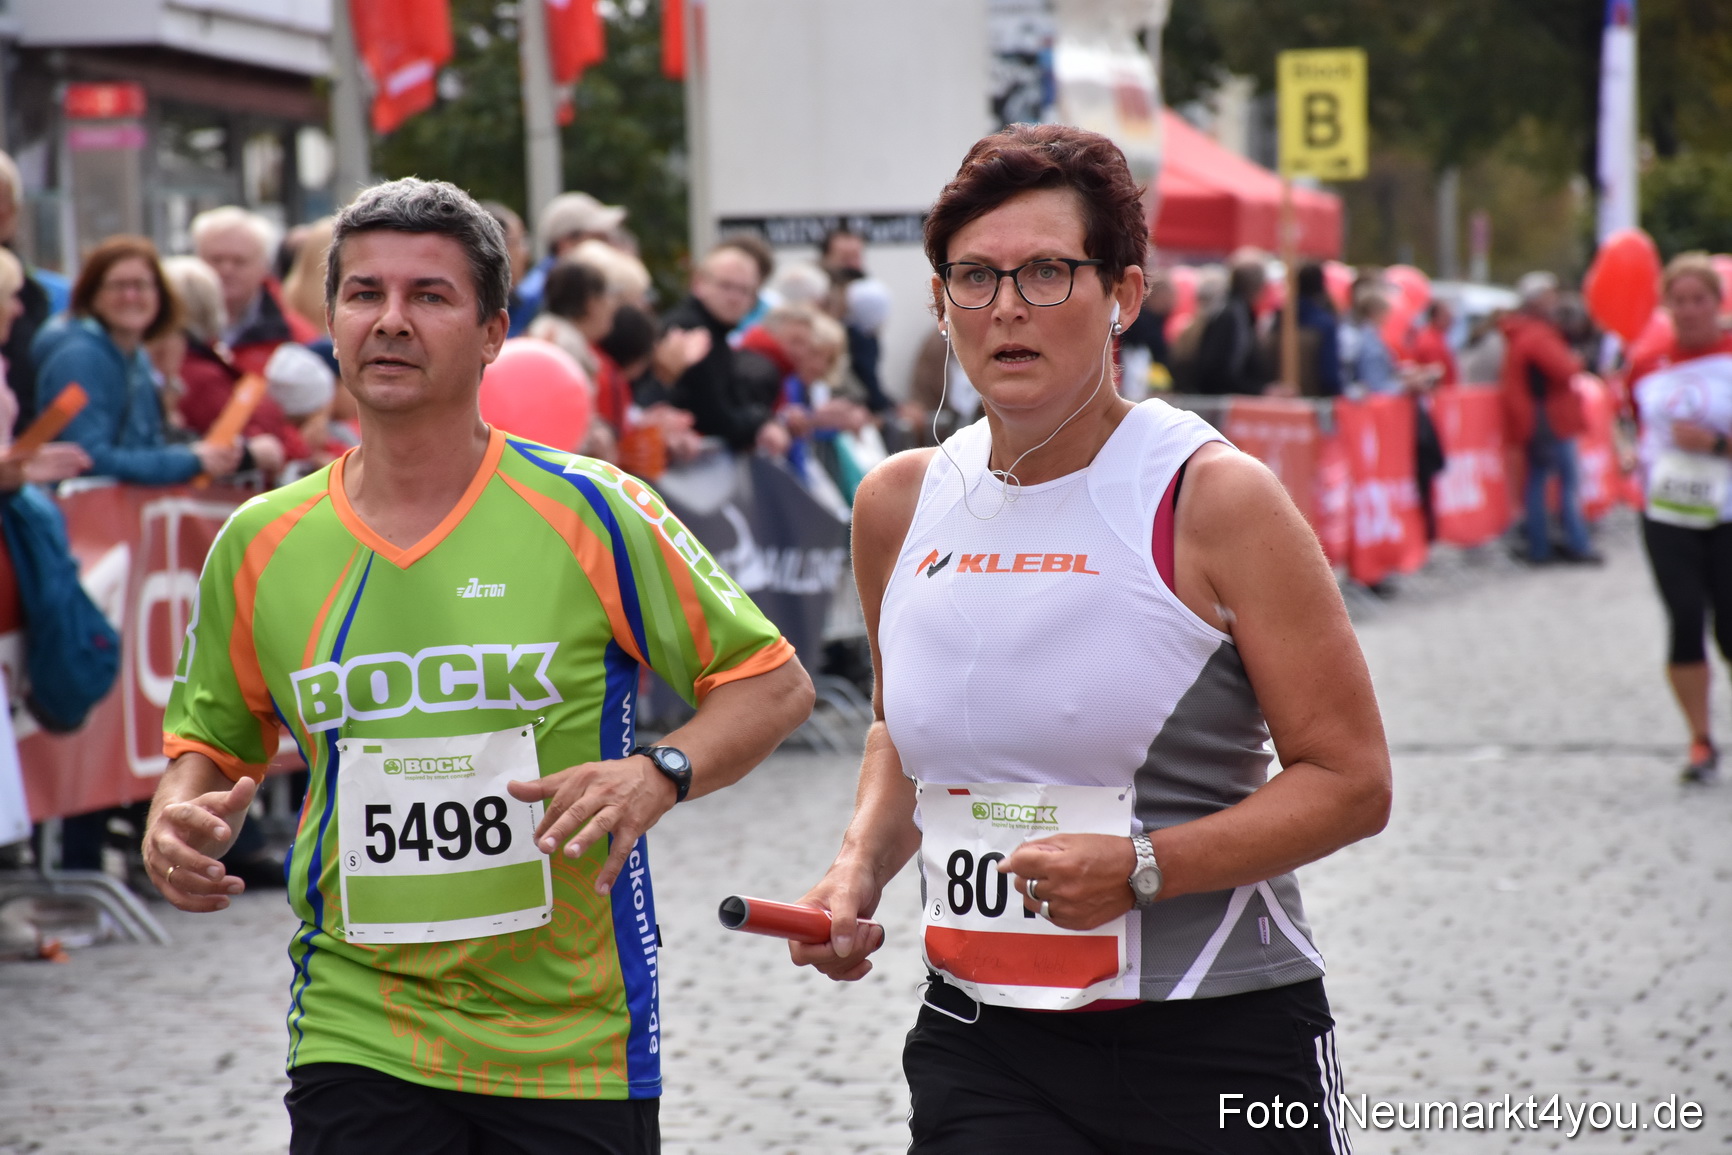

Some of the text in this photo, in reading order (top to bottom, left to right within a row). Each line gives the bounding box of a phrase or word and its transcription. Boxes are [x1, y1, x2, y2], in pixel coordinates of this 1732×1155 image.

[1303, 91, 1343, 149] B
[562, 455, 743, 617] BOCK
[955, 553, 1100, 576] KLEBL
[289, 641, 564, 734] BOCK
[403, 755, 474, 774] BOCK
[365, 795, 512, 864] 5498
[991, 802, 1058, 824] BOCK
[350, 856, 356, 866] S
[946, 849, 1036, 919] 80
